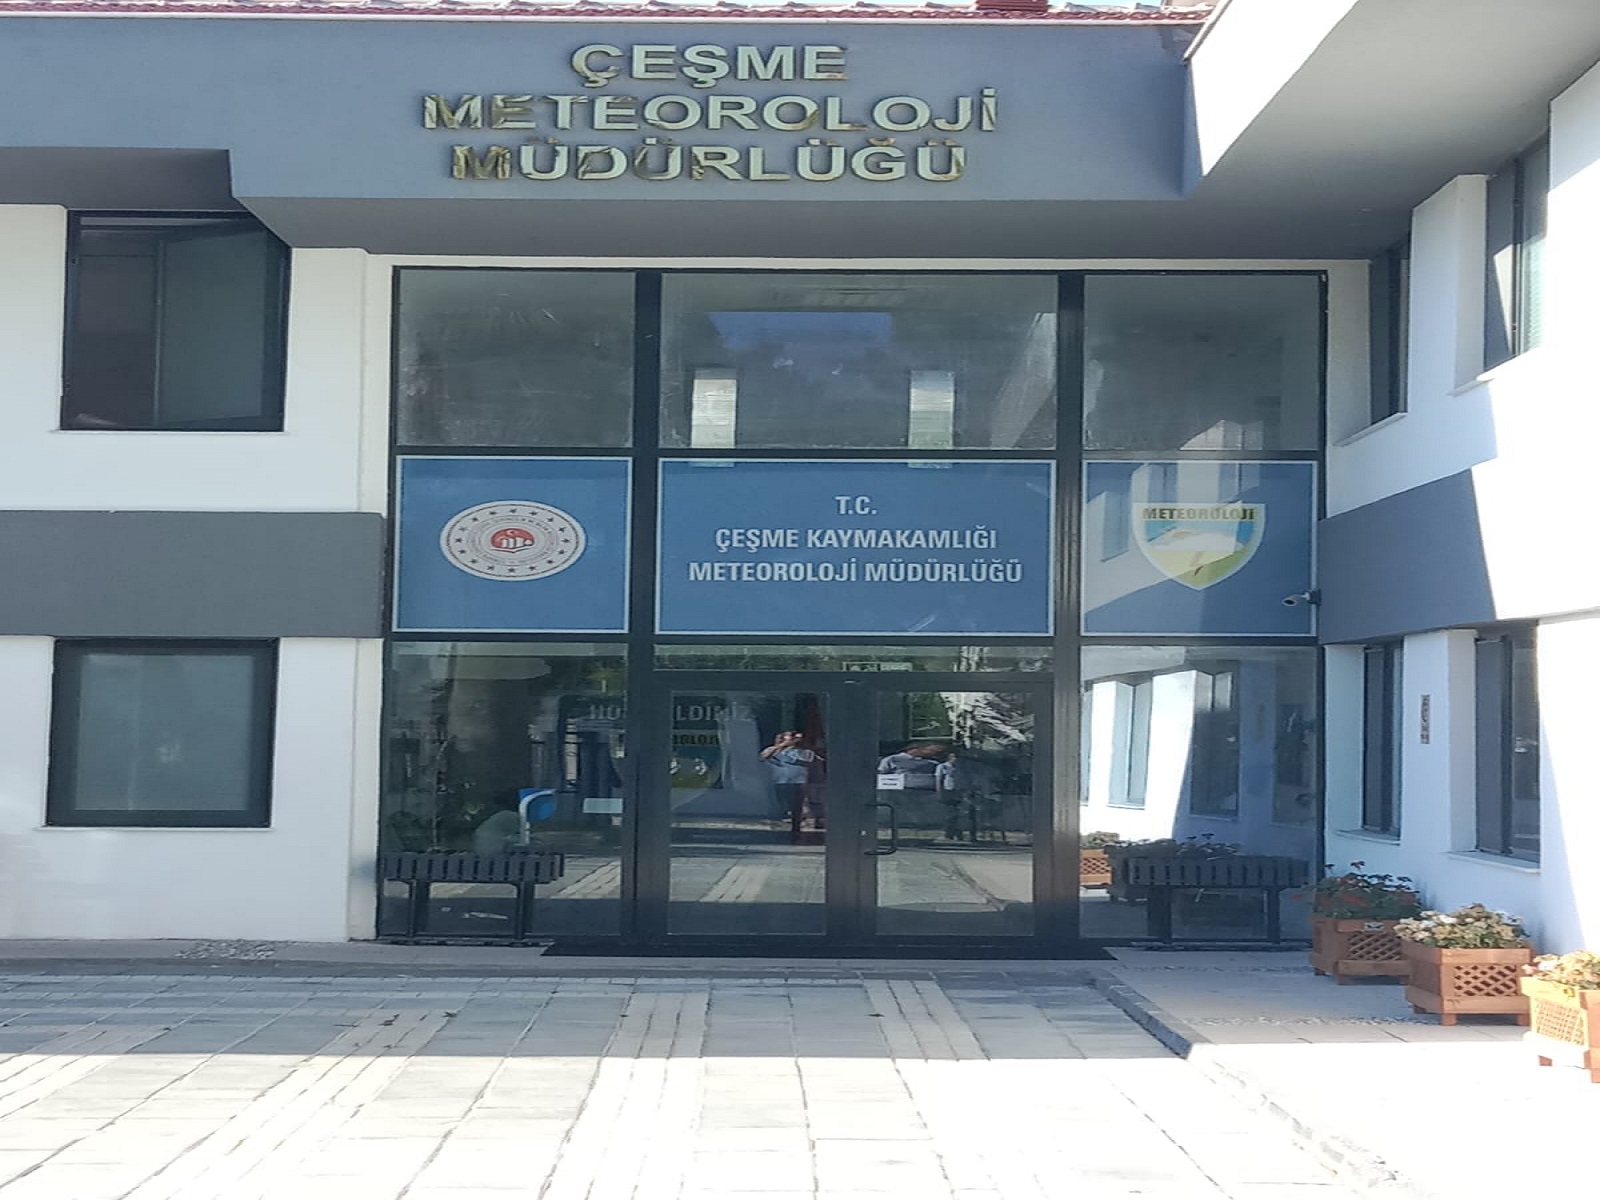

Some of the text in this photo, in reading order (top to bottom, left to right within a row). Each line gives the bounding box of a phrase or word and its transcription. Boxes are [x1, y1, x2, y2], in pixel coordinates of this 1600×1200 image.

[572, 43, 847, 88] ÇEŞME
[423, 88, 998, 131] METEOROLOJİ
[452, 137, 967, 182] MÜDÜRLÜĞÜ
[834, 495, 878, 515] T.C.
[715, 524, 997, 553] ÇEŞME KAYMAKAMLIĞI
[688, 556, 1023, 583] METEOROLOJİ MÜDÜRLÜĞÜ
